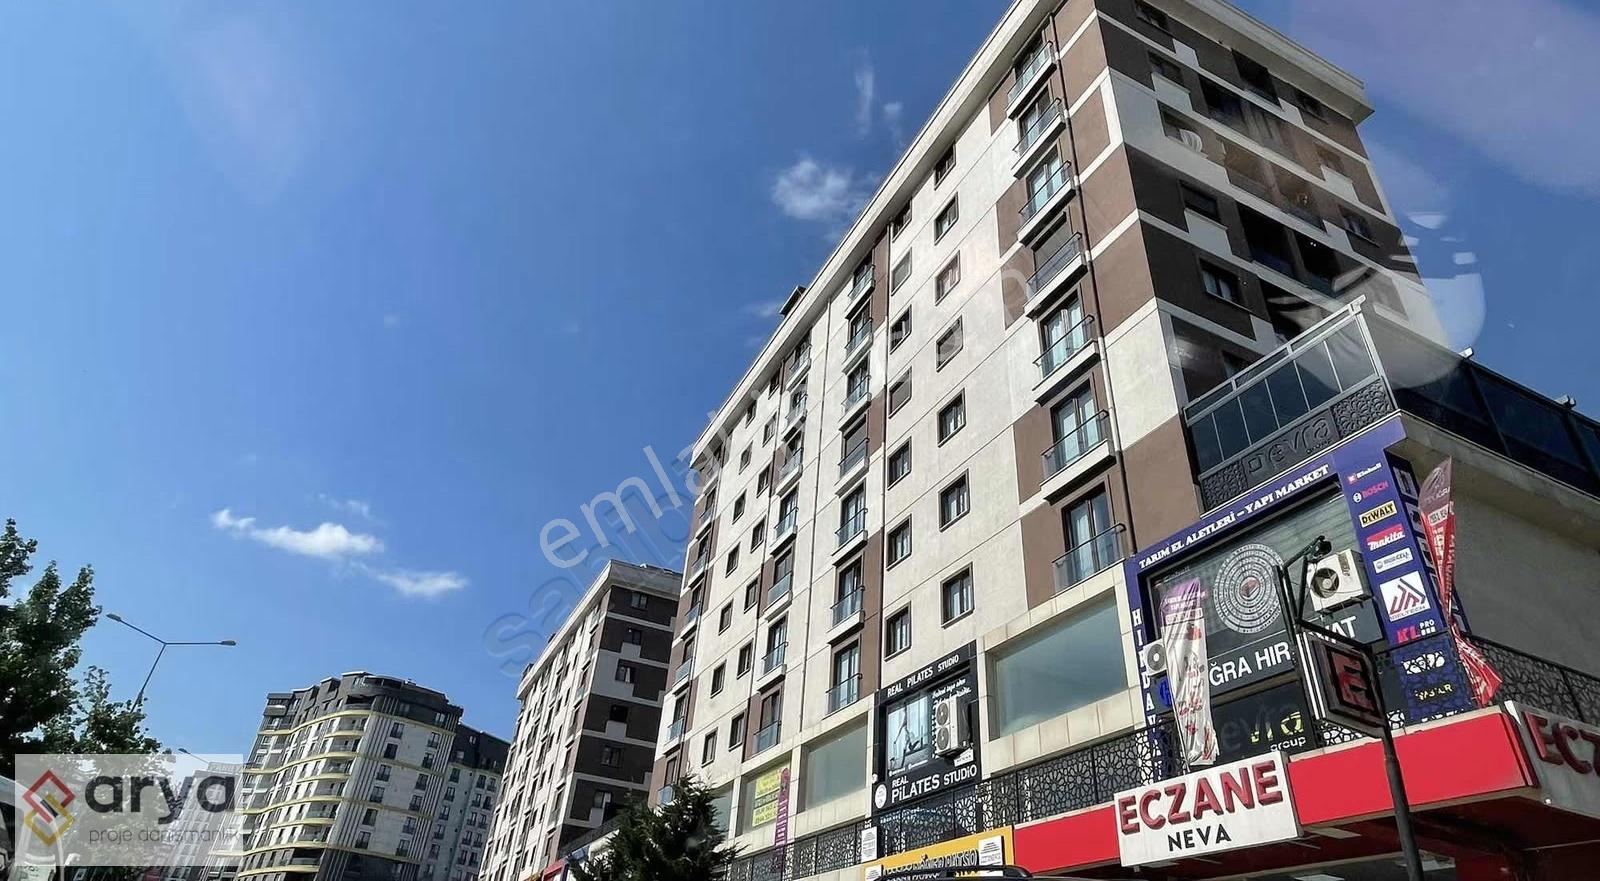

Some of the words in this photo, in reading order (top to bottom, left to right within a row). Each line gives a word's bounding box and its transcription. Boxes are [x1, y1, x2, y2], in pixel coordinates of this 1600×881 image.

[1361, 480, 1389, 499] BOSCH
[1138, 548, 1171, 569] TARIM
[1171, 541, 1185, 553] EL
[1185, 511, 1236, 547] ALETLERİ
[1244, 494, 1274, 516] YAPI
[1274, 464, 1329, 500] MARKET
[1367, 530, 1405, 551] makita
[1419, 619, 1435, 630] PRO
[887, 683, 903, 698] REAL
[891, 775, 909, 788] REAL
[1118, 759, 1283, 836] ECZANE
[1167, 823, 1231, 851] NEVA
